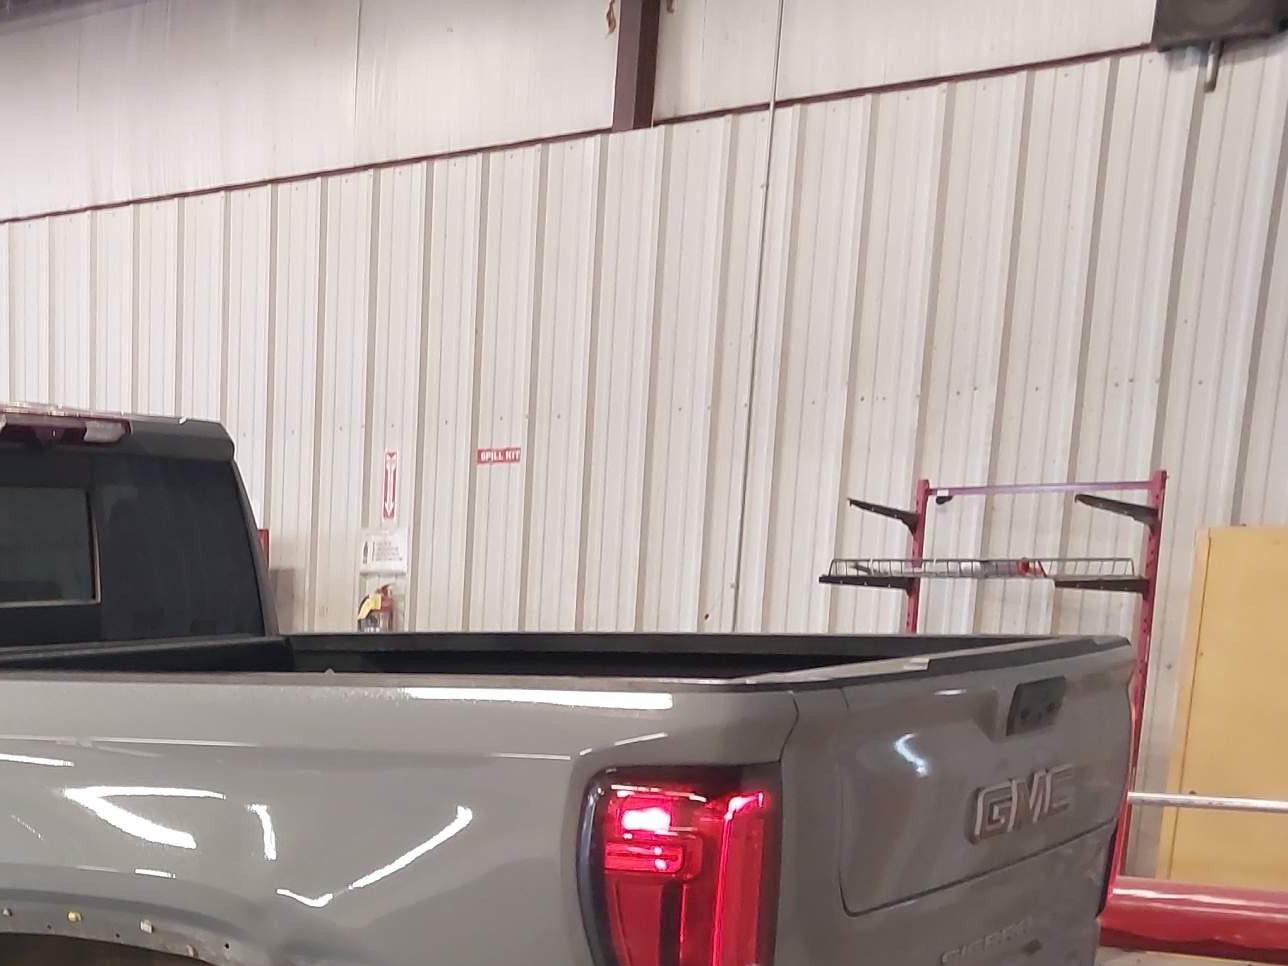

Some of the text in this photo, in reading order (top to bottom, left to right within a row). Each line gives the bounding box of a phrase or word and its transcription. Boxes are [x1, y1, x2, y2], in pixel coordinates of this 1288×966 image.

[480, 449, 520, 461] SPILL KIT
[972, 765, 1073, 842] GMC
